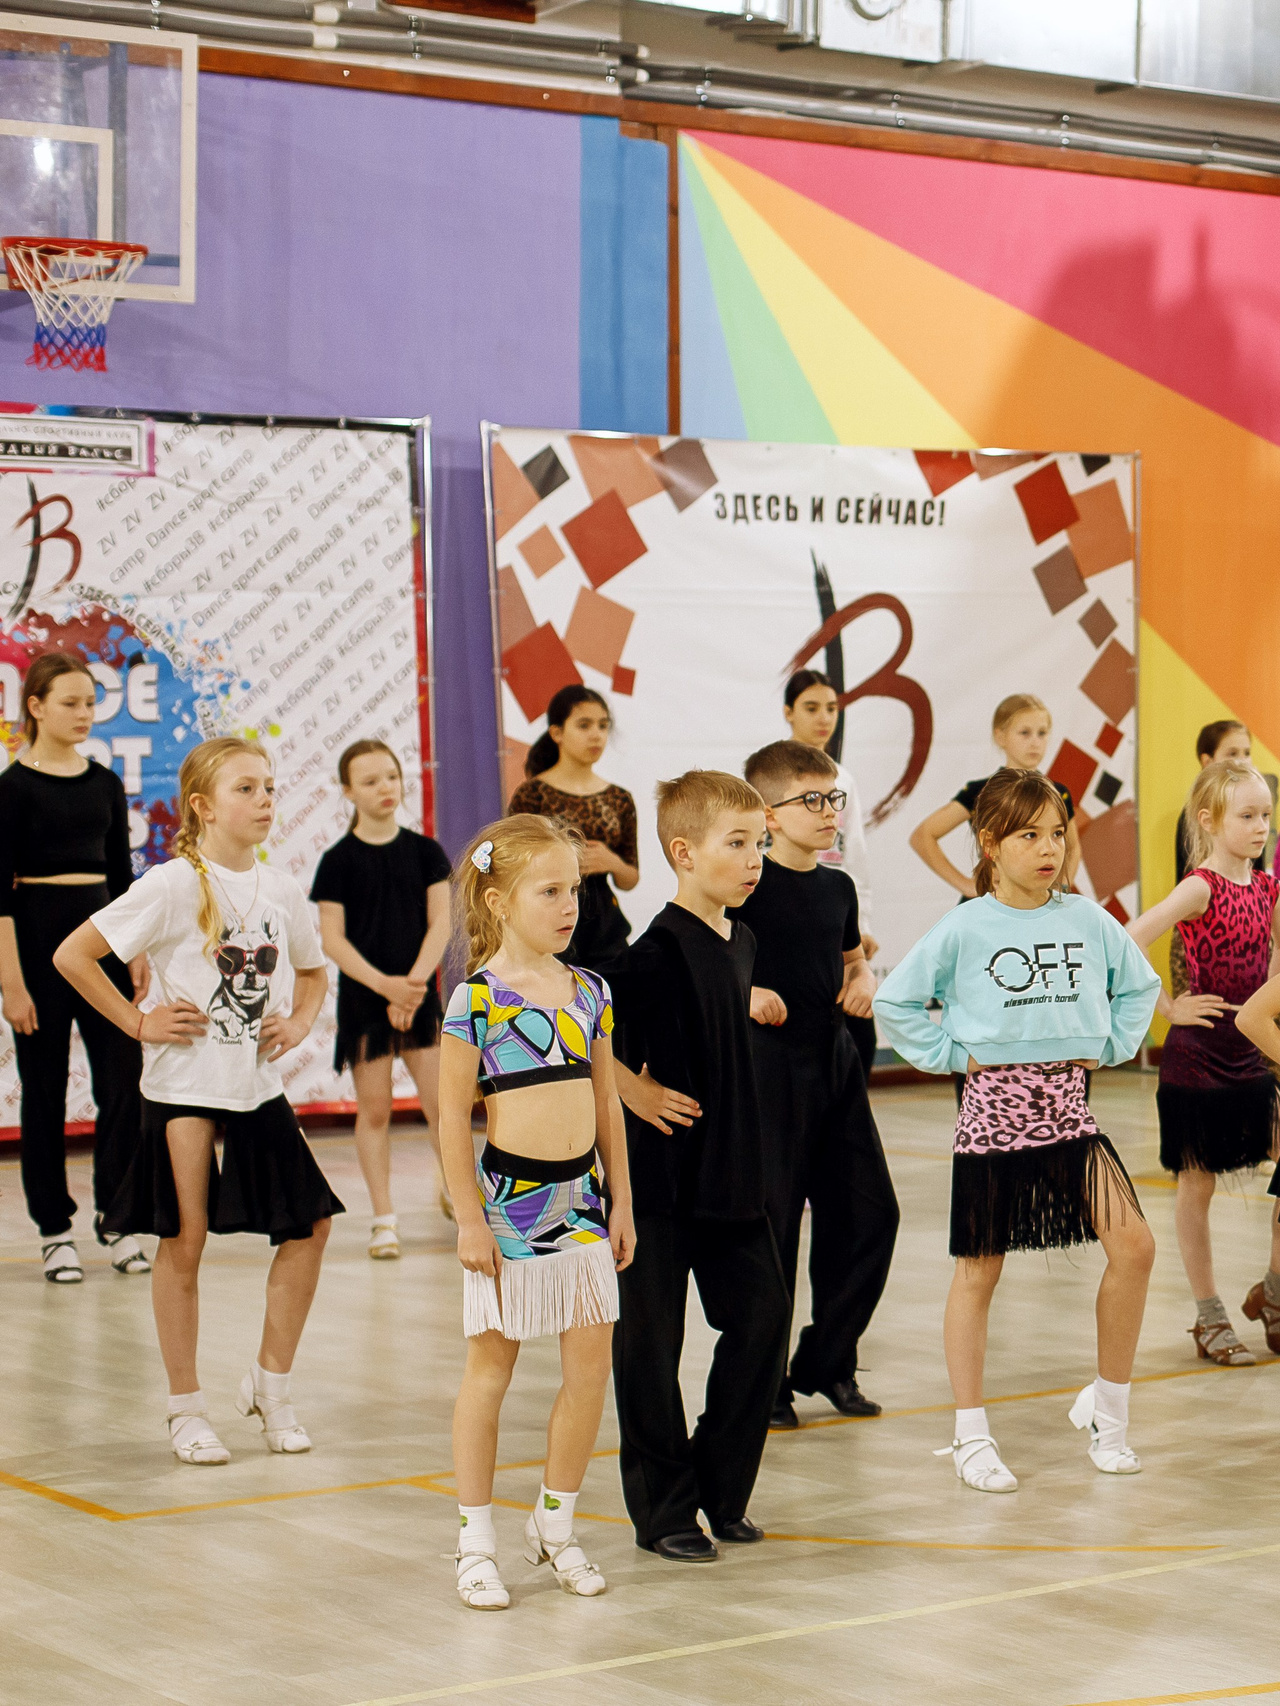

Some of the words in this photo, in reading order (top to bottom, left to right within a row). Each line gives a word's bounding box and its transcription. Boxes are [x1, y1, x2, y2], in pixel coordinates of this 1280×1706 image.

[109, 547, 146, 584] camp
[145, 508, 188, 549] Dance
[187, 479, 222, 512] sport
[221, 449, 254, 484] camp
[713, 492, 799, 524] ЗДЕСЬ
[811, 496, 824, 523] И
[836, 492, 946, 526] СЕЙЧАС!
[191, 588, 233, 628] Dance
[231, 556, 268, 592] sport
[265, 526, 300, 563] camp
[307, 480, 347, 520] Dance
[269, 639, 310, 680] Dance
[309, 607, 343, 643] sport
[341, 577, 376, 614] camp
[322, 713, 362, 752] Dance
[361, 680, 394, 714] sport
[984, 942, 1084, 993] OFF
